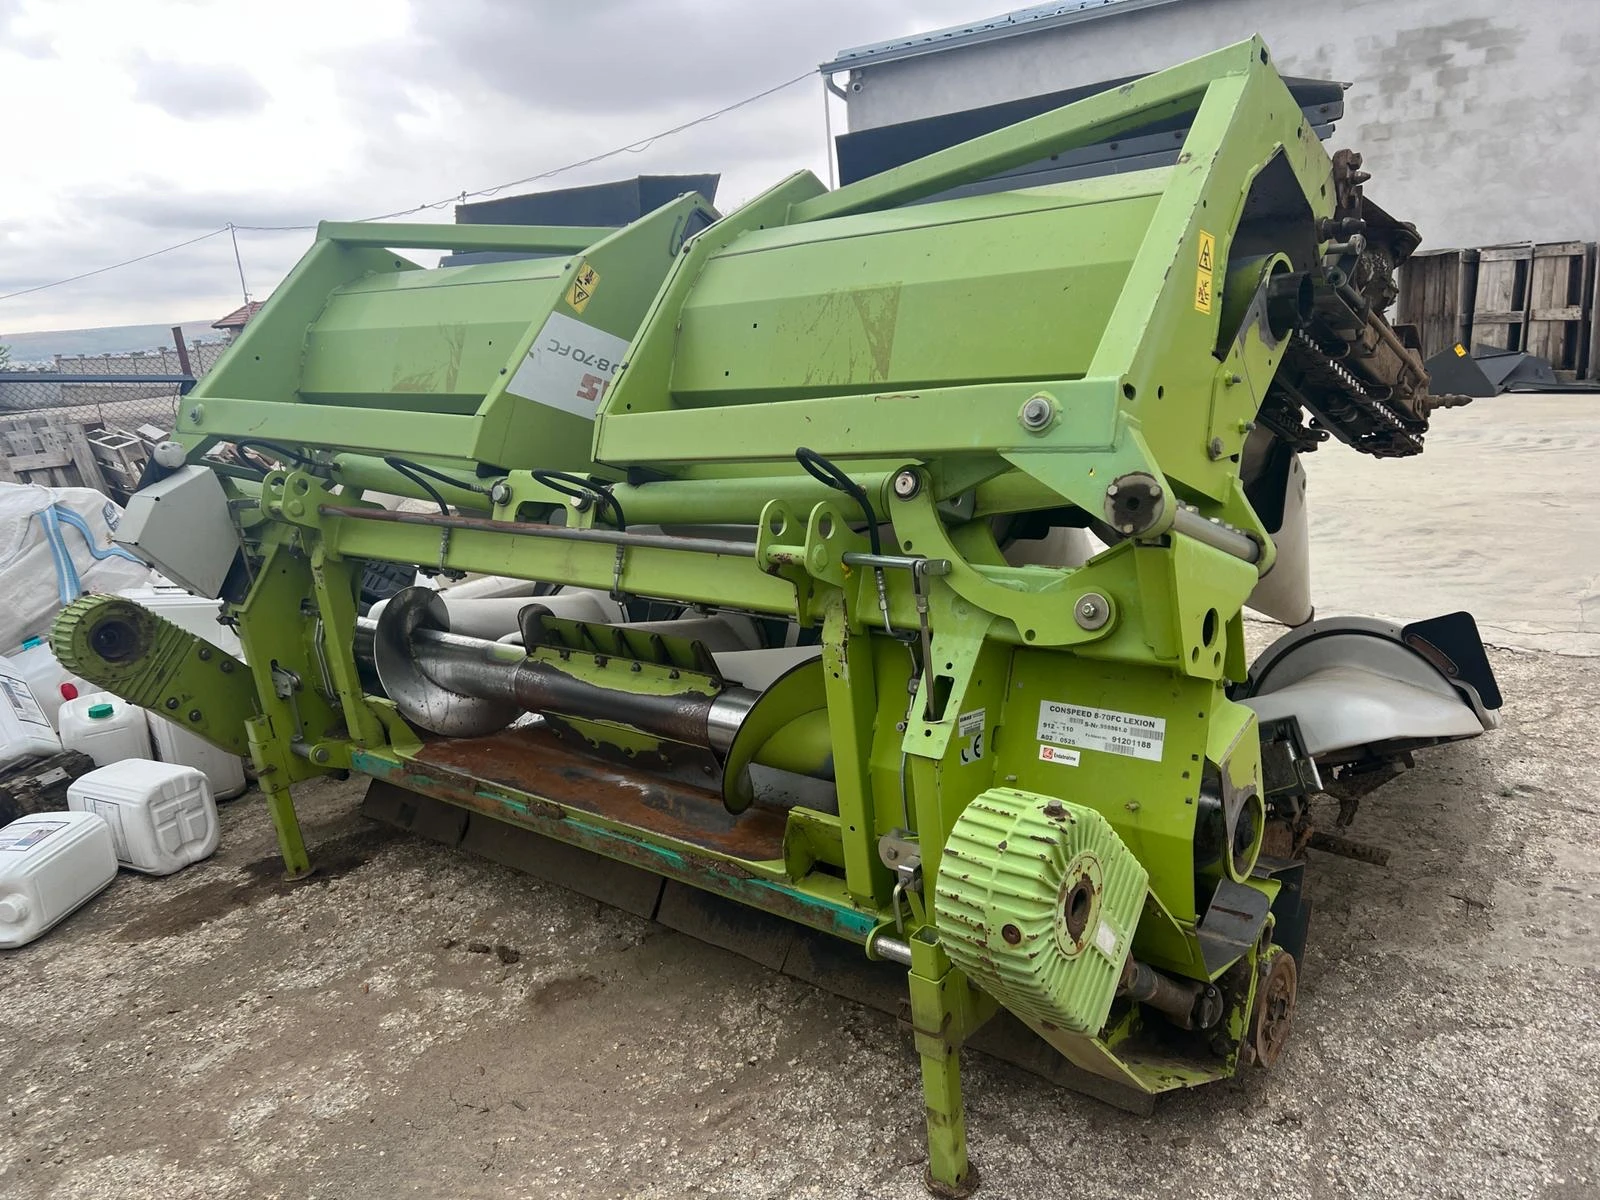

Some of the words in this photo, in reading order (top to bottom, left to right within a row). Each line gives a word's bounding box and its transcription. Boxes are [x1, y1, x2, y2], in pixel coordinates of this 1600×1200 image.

[1050, 705, 1092, 718] CONSPEED
[1094, 712, 1121, 723] 8-70FC
[1123, 717, 1155, 728] LEXION
[1112, 736, 1151, 749] 91201188
